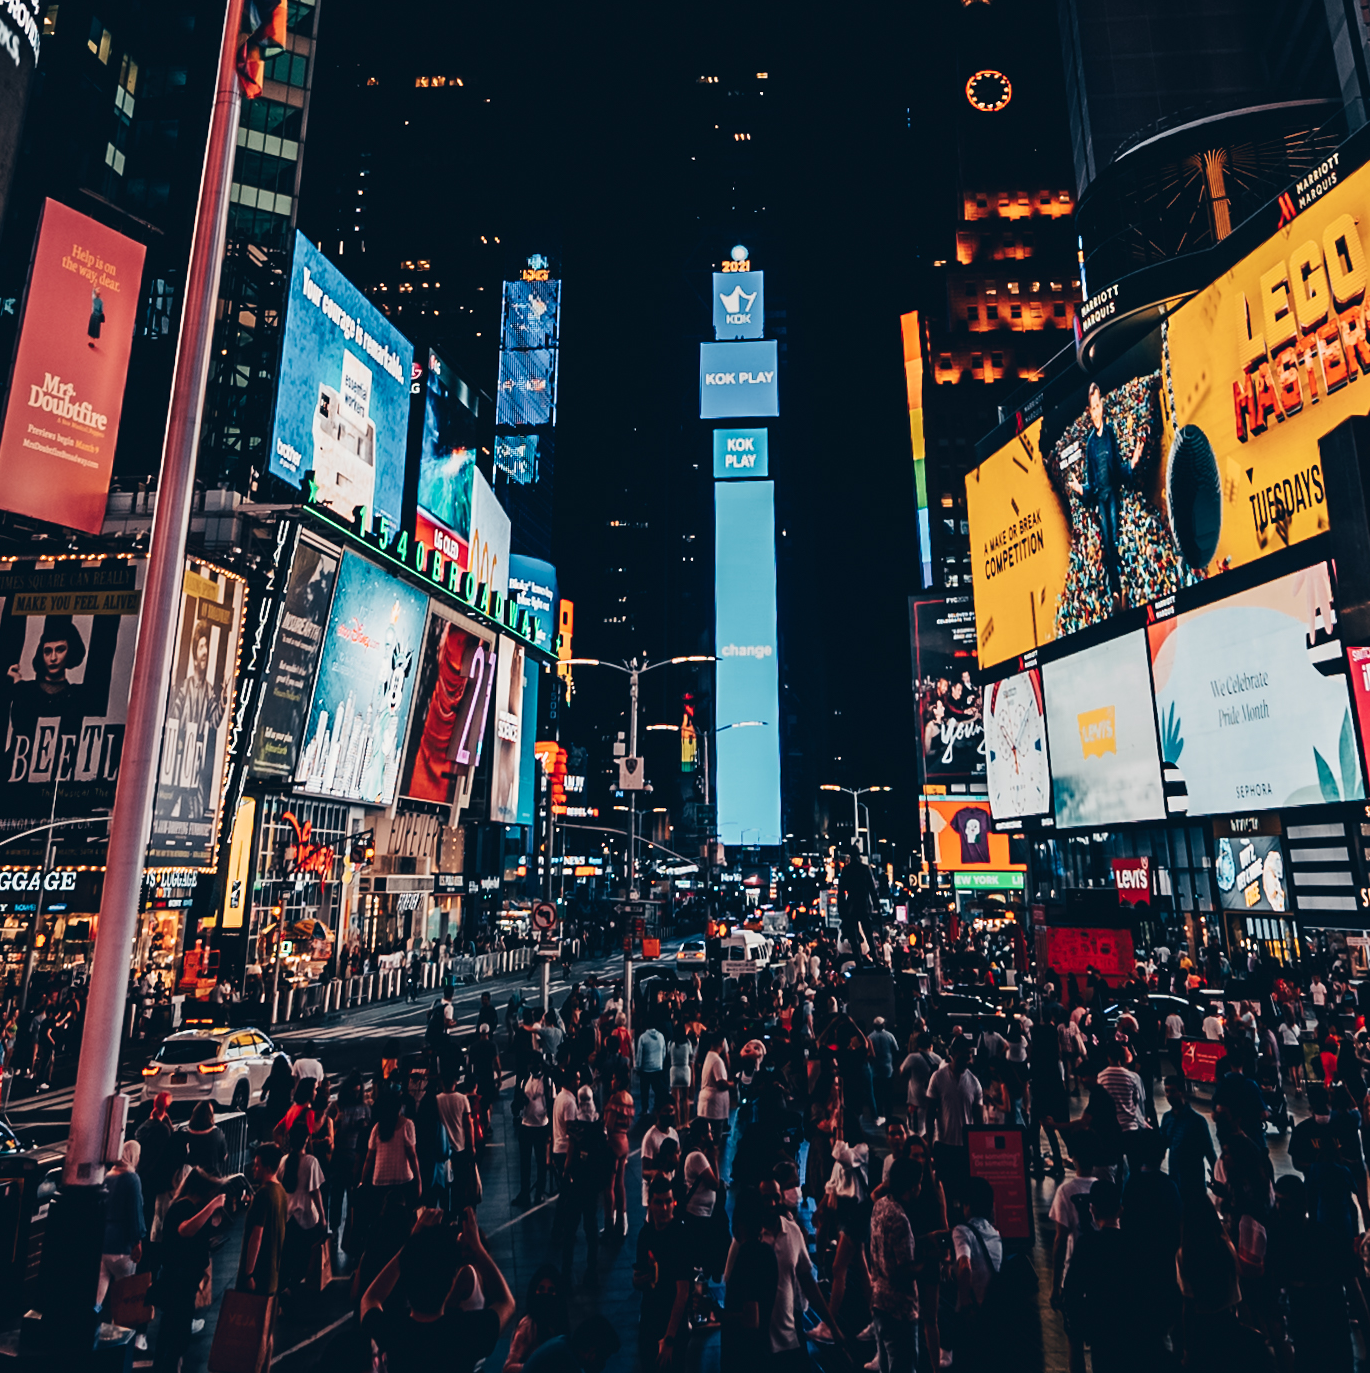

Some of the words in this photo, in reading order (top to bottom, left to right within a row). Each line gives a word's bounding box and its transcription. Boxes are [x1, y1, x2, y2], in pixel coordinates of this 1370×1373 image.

[1296, 152, 1340, 194] MARRIOTT
[1298, 171, 1338, 211] MARQUIS
[61, 255, 78, 273] the
[79, 265, 98, 288] way,
[99, 272, 121, 293] dear.
[72, 243, 95, 268] Help
[95, 255, 104, 270] is
[104, 263, 116, 276] on
[722, 260, 750, 273] 2021
[1080, 284, 1119, 318] MARRIOTT
[1235, 212, 1370, 368] LEGO
[303, 266, 323, 308] Your
[322, 294, 356, 341] courage
[355, 318, 363, 346] is
[726, 313, 752, 325] KOK
[1082, 301, 1116, 332] MARQUIS
[42, 371, 78, 397] Mrs.
[705, 372, 736, 385] KOK
[738, 371, 774, 385] PLAY
[28, 384, 109, 431] Doubtfire
[727, 438, 754, 452] KOK
[725, 455, 756, 468] PLAY
[1249, 465, 1325, 533] TUESDAYS
[434, 528, 444, 550] LG
[443, 535, 459, 560] OLED
[983, 542, 990, 555] A
[990, 531, 1008, 552] MAKE
[1008, 525, 1018, 540] OR
[1019, 512, 1042, 537] BREAK
[984, 530, 1045, 581] COMPETITION
[358, 505, 424, 572] 1540
[432, 549, 541, 642] BROADWAY
[15, 595, 48, 612] MAKE
[50, 595, 72, 612] YOU
[73, 594, 101, 611] FEEL
[101, 593, 139, 610] ALIVE!
[721, 643, 772, 659] change
[1210, 677, 1227, 699] We
[1227, 670, 1270, 695] Celebrate
[1217, 705, 1240, 727] Pride
[1241, 698, 1271, 724] Month
[1235, 784, 1273, 799] SEPHORA
[973, 875, 1000, 886] YORK
